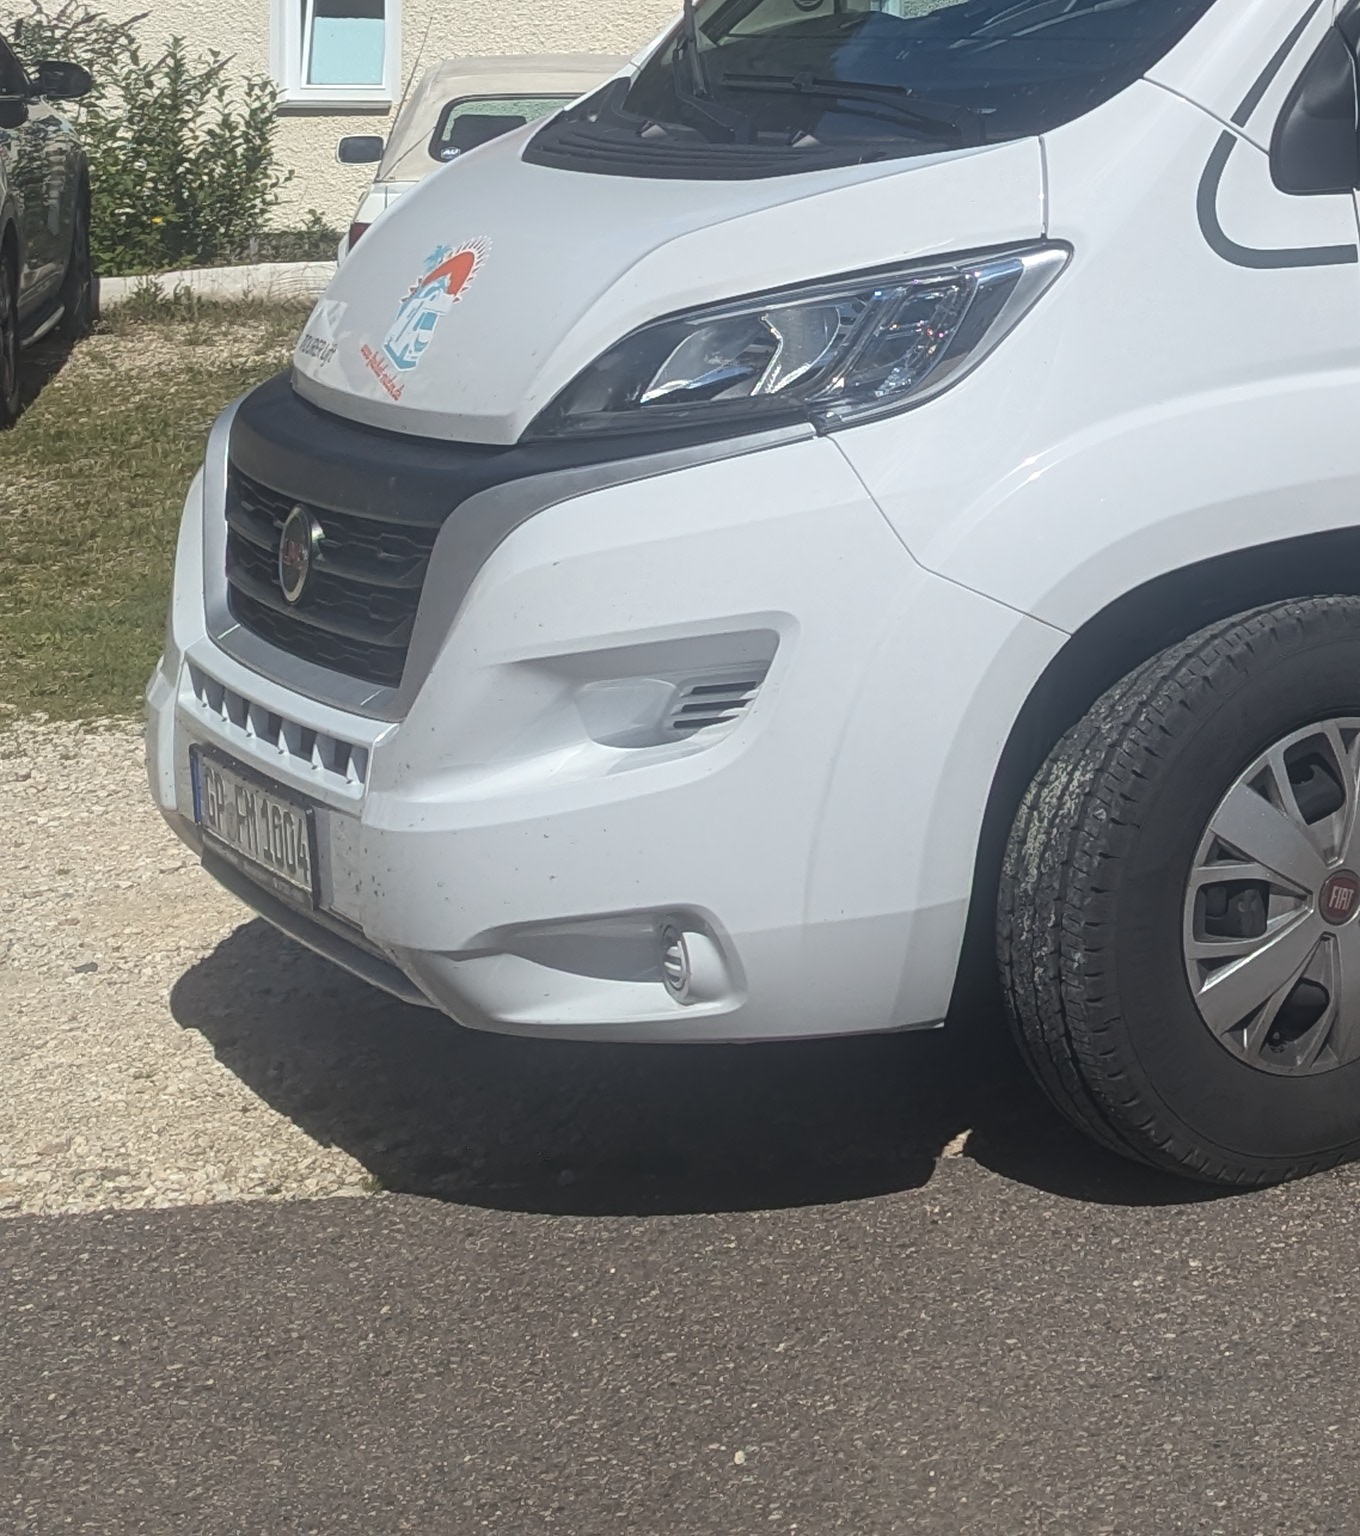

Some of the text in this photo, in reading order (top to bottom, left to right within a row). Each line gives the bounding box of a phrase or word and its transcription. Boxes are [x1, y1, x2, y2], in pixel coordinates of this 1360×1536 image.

[205, 765, 226, 831] GP
[261, 798, 312, 886] 1004
[1328, 885, 1355, 912] FIAT
